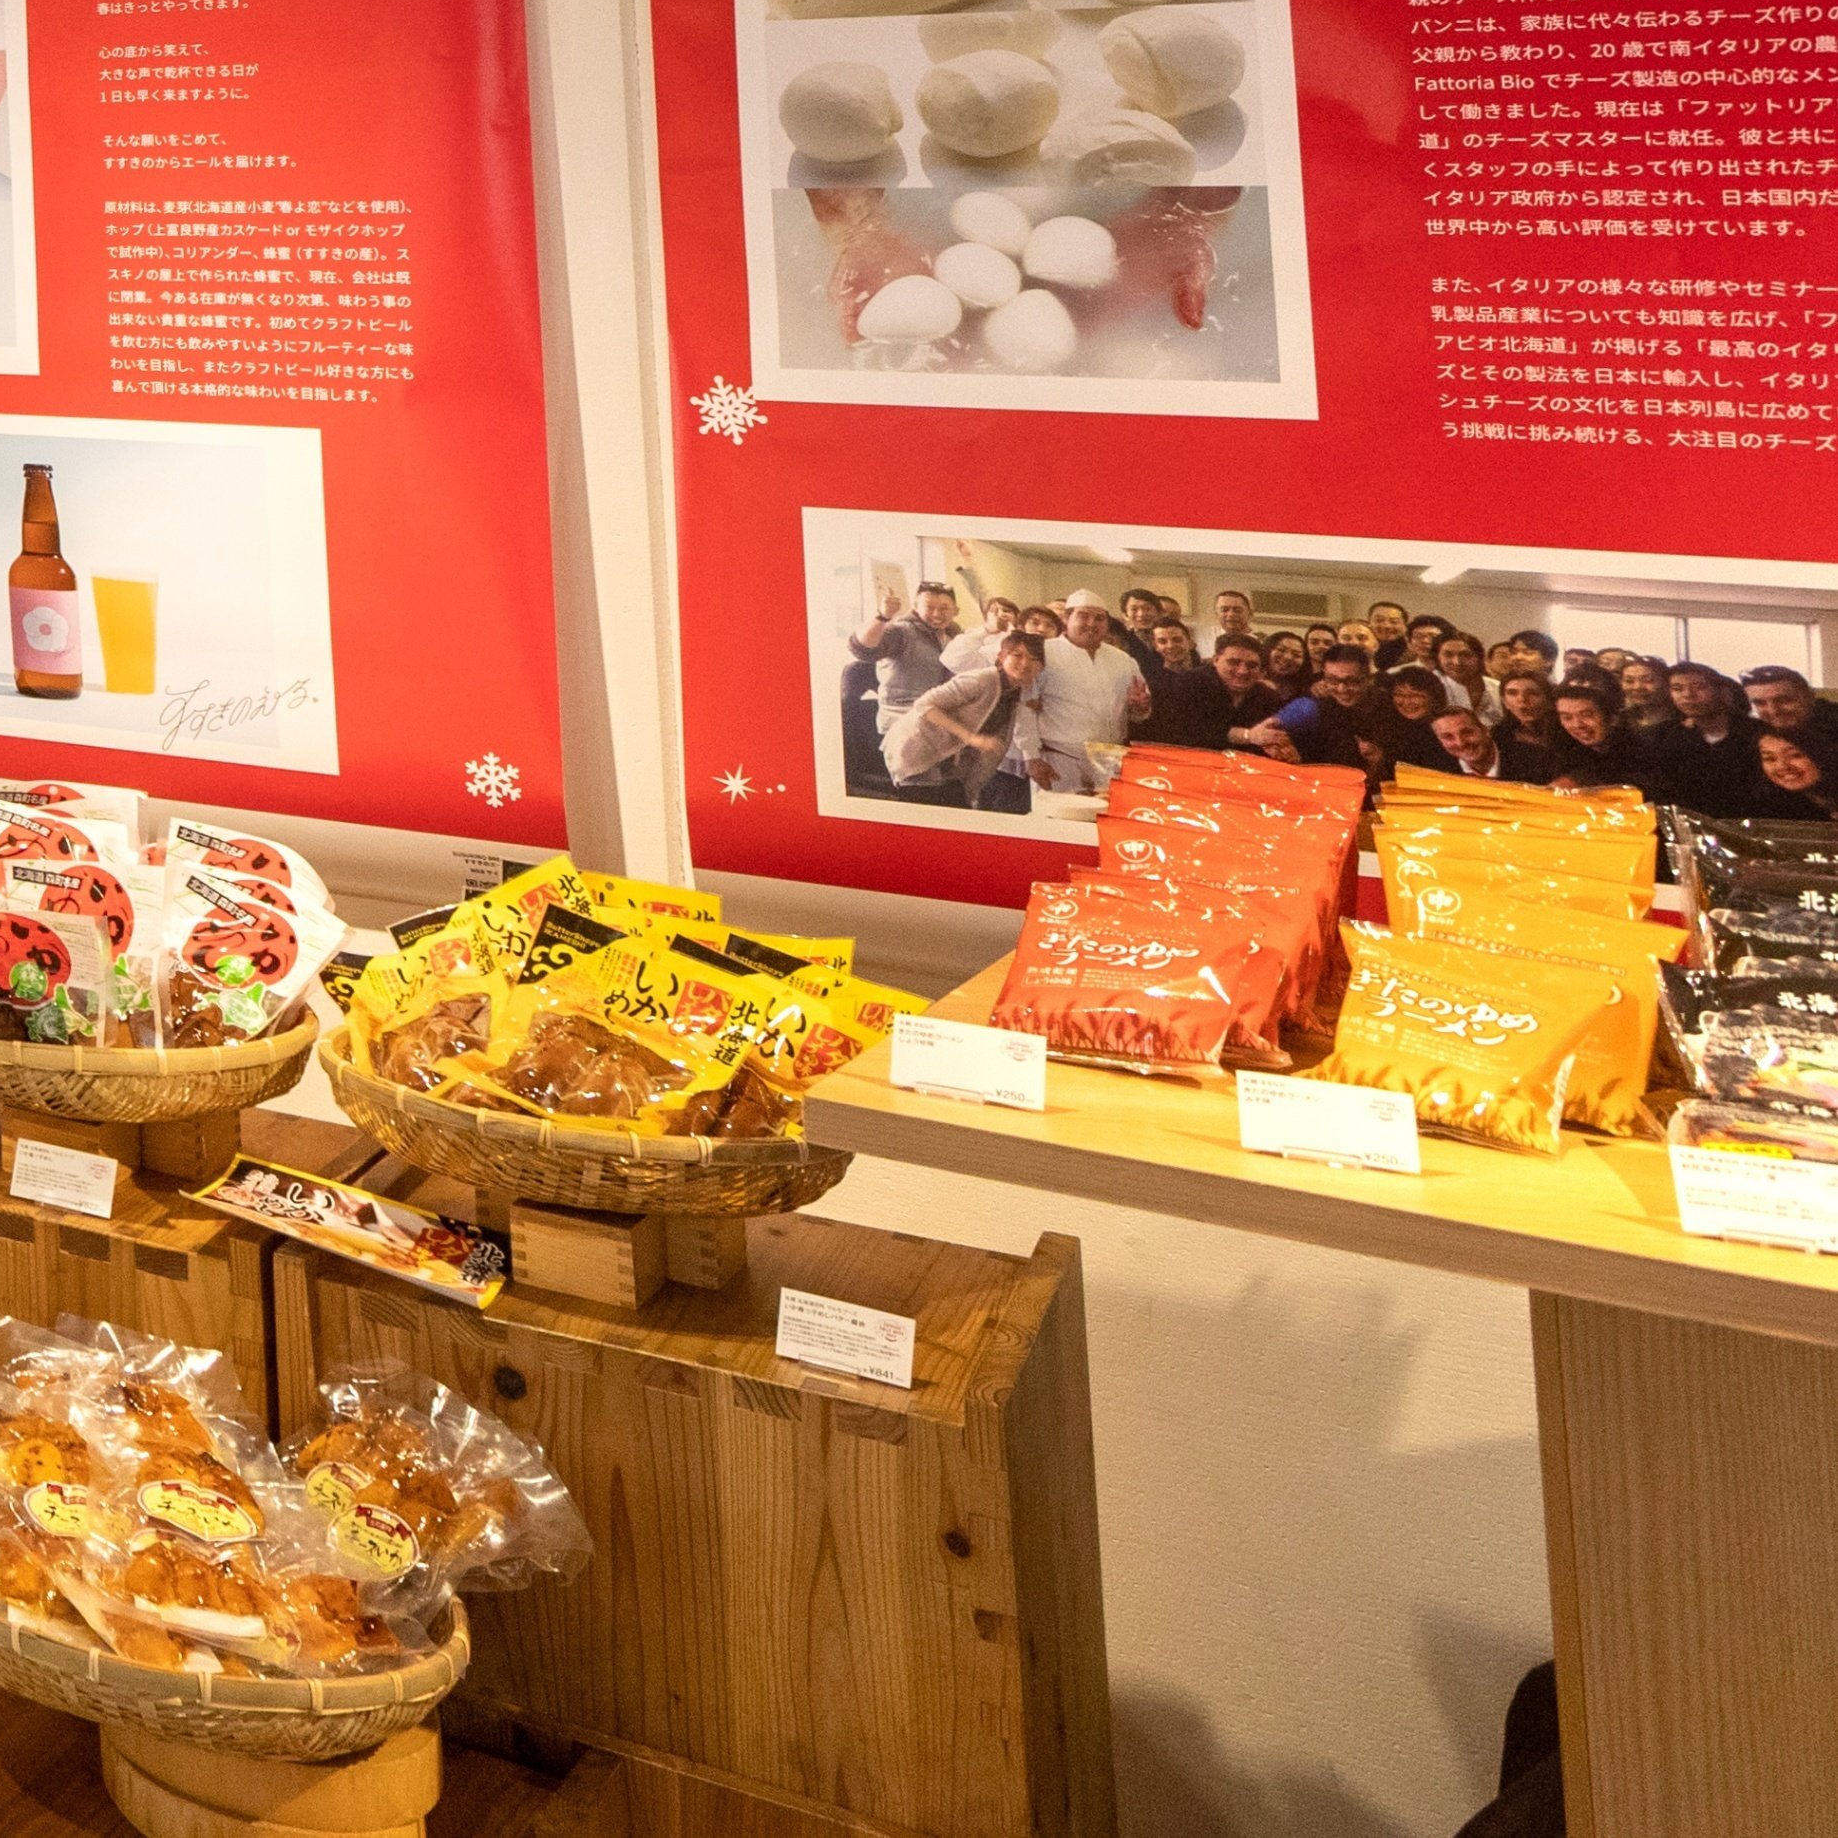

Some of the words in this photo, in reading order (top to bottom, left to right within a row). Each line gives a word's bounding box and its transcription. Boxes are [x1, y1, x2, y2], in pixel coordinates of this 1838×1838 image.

[98, 43, 210, 60] 心の底から笑えて、
[99, 63, 259, 82] 大きな声で乾杯できる日が
[1414, 73, 1494, 91] Fattoria
[1500, 73, 1534, 89] Bio
[103, 132, 227, 148] そんな願いをこめて、
[104, 154, 298, 169] すすきのからエールを届けます。
[286, 225, 300, 237] or
[305, 223, 405, 238] モザイクホップ
[1425, 219, 1807, 237] 世界中から高い評価を受けています。
[1348, 968, 1539, 1034] きたのゆめ
[1364, 994, 1507, 1046] ラーメン
[710, 999, 762, 1068] 北海道
